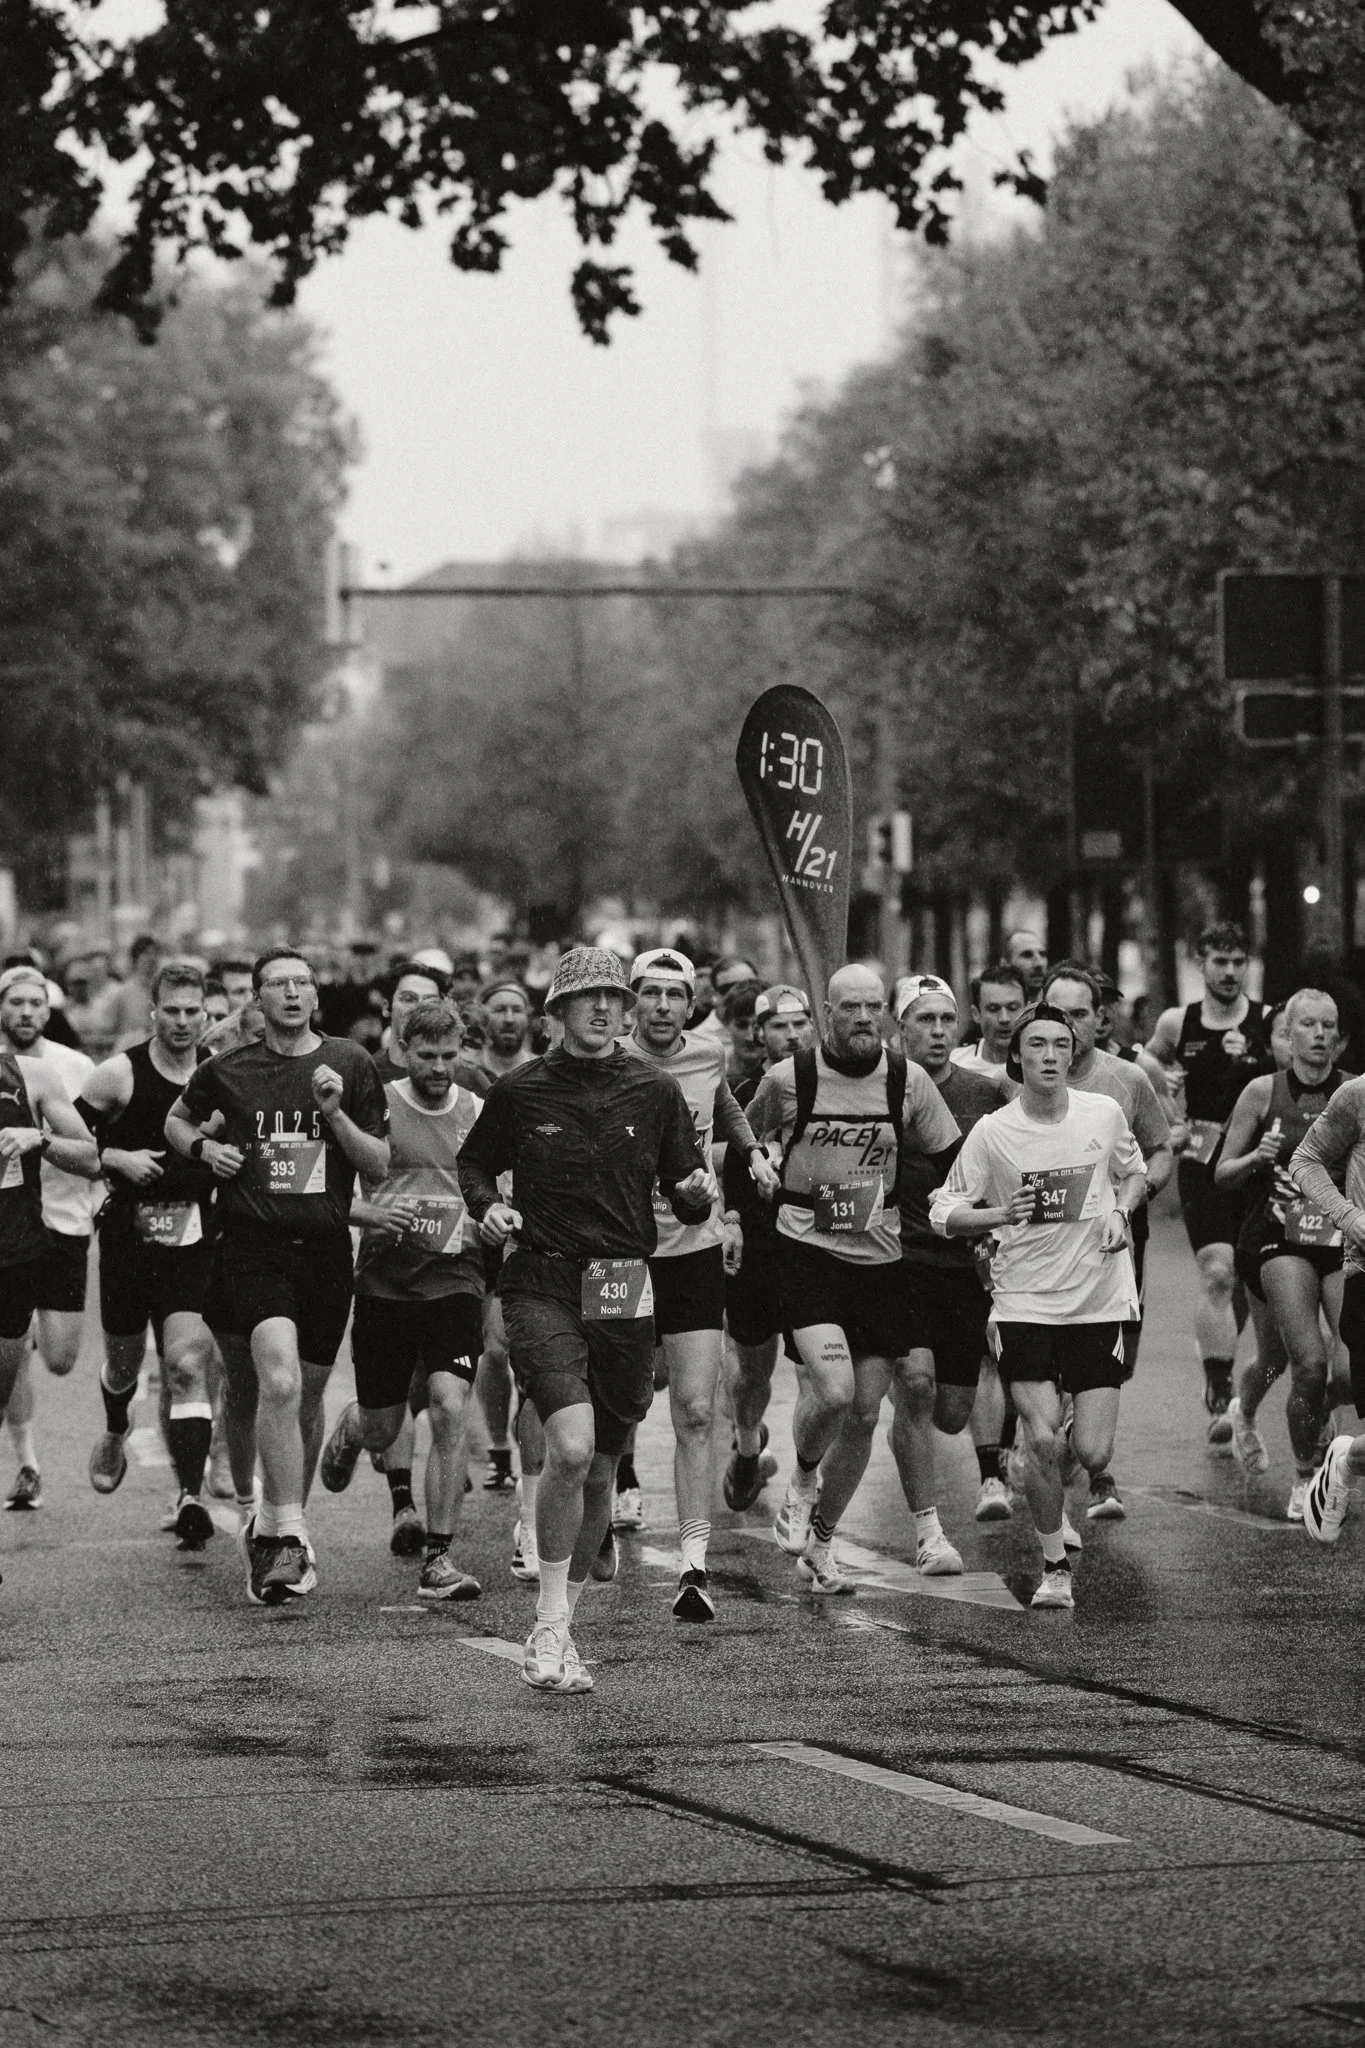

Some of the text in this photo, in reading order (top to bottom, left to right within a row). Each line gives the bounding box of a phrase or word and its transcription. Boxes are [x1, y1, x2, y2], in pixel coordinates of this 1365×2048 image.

[760, 731, 824, 796] 1:30
[781, 874, 834, 894] HANNOVER
[256, 1110, 321, 1139] 2025
[270, 1160, 296, 1176] 393
[269, 1180, 291, 1190] Sören
[1041, 1188, 1067, 1206] 347
[831, 1200, 855, 1217] 131
[1043, 1210, 1064, 1219] Henri
[149, 1216, 173, 1231] 345
[410, 1217, 442, 1235] 3701
[830, 1222, 853, 1230] Jonas
[1298, 1215, 1323, 1230] 422
[600, 1282, 628, 1299] 430
[600, 1305, 622, 1315] Noah
